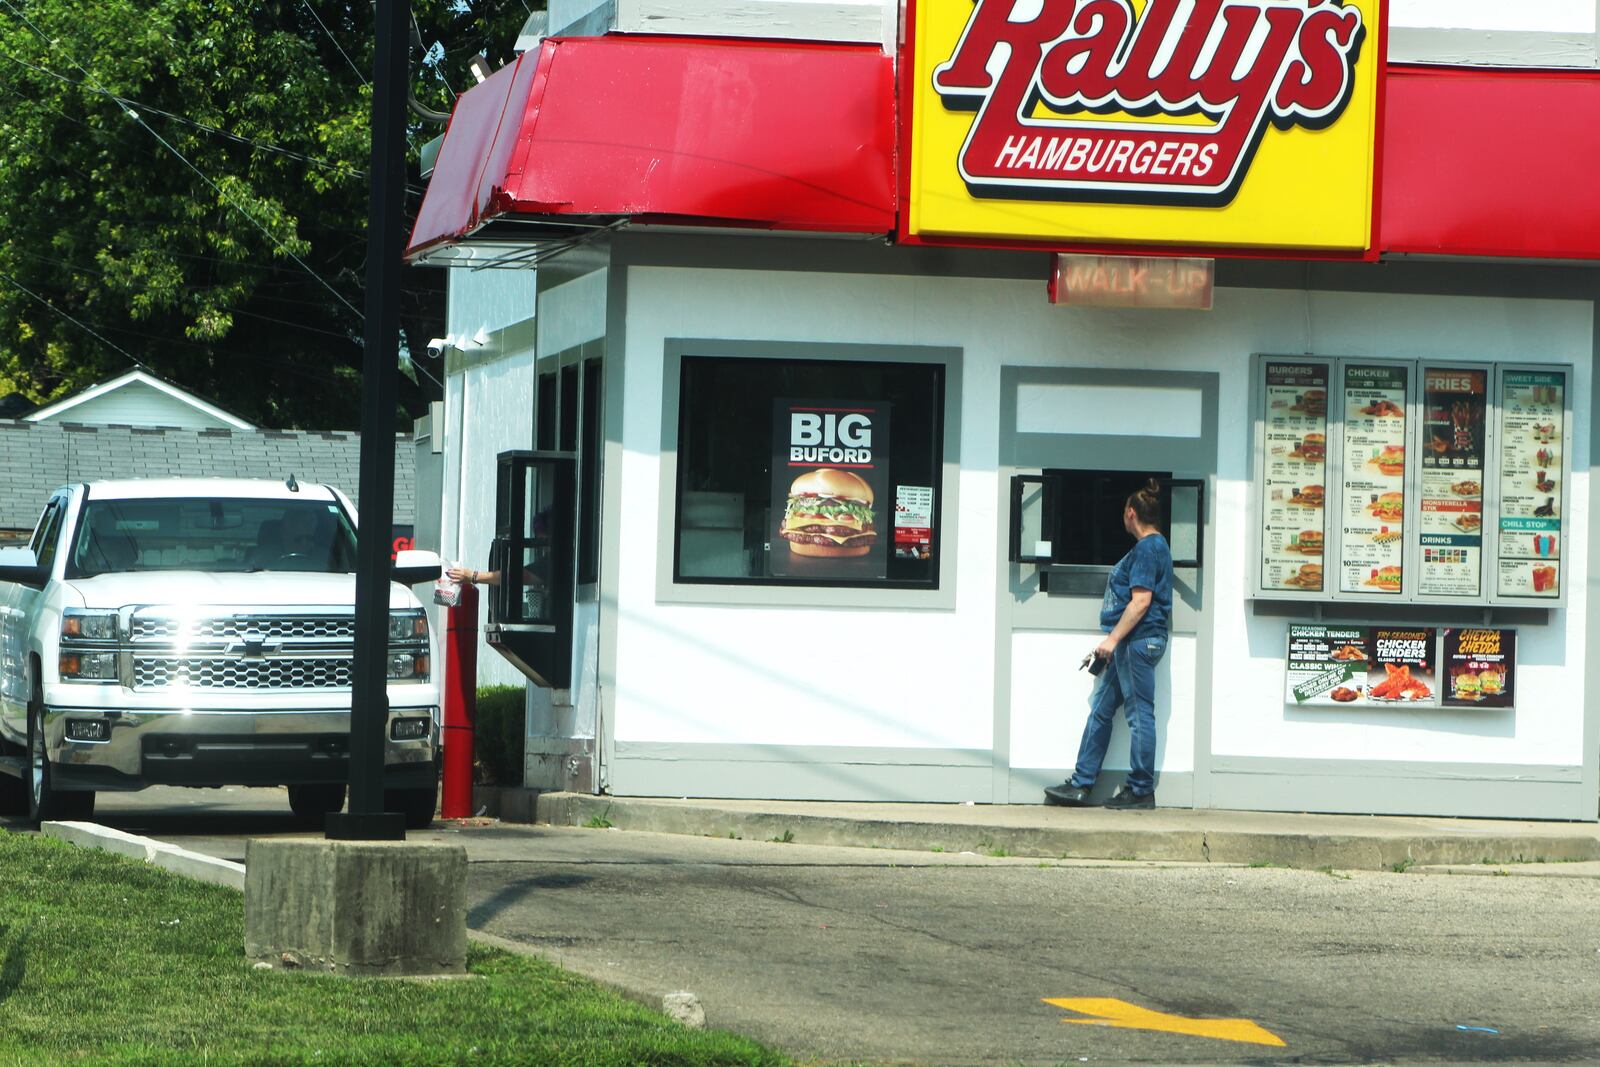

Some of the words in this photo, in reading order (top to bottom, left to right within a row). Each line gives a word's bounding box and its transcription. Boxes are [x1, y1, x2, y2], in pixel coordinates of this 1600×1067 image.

[994, 135, 1219, 177] HAMBURGERS
[1066, 263, 1208, 295] WALK-UP
[1268, 366, 1313, 375] BURGERS
[1347, 368, 1390, 378] CHICKEN
[1425, 378, 1472, 391] FRIES
[791, 412, 872, 448] BIG
[790, 447, 872, 463] BUFORD
[1502, 520, 1524, 528] CHILL
[1526, 521, 1548, 529] STOP
[1421, 536, 1452, 544] DRINKS
[1459, 629, 1501, 641] CHEDDA
[1376, 639, 1427, 649] CHICKEN
[1458, 641, 1500, 653] CHEDDA
[1376, 648, 1426, 658] TENDERS
[1290, 662, 1323, 670] CLASSIC
